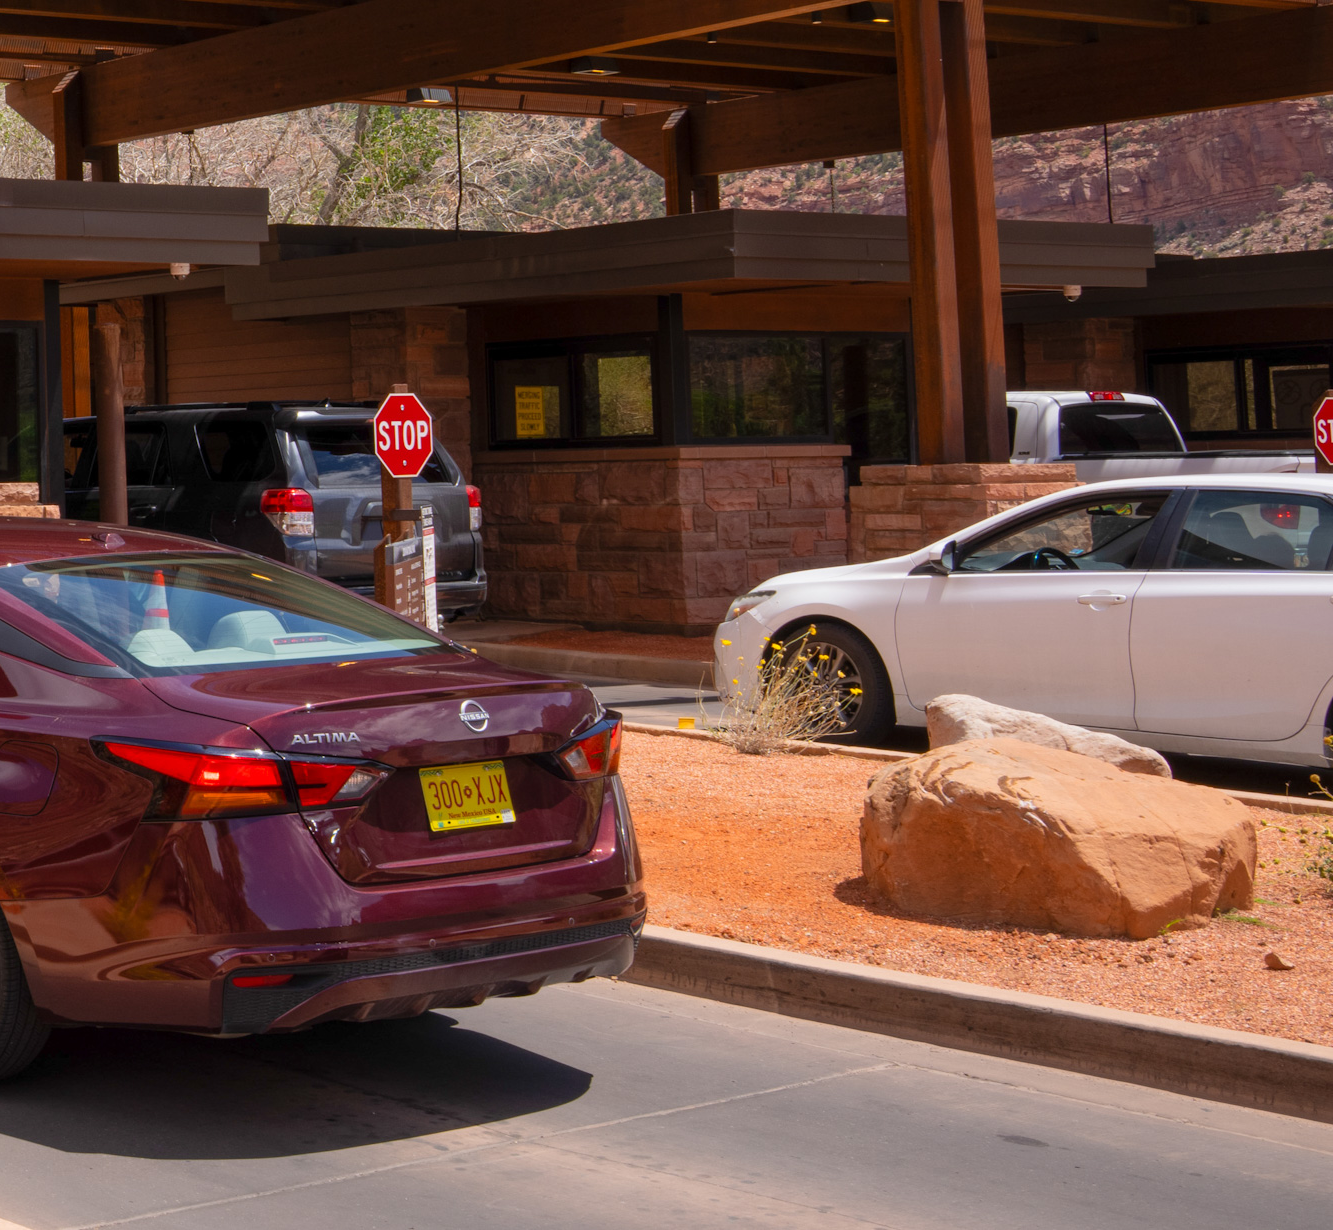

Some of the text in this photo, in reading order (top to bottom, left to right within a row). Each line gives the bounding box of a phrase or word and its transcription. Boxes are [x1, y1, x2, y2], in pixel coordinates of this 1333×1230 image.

[519, 402, 540, 410] TRAFFIC
[518, 412, 541, 420] PROCEED
[521, 423, 540, 431] SLOWLY
[378, 420, 429, 451] STOP
[1317, 419, 1333, 444] ST
[460, 712, 490, 721] NISSAN
[291, 732, 361, 745] ALTIMA
[461, 810, 483, 818] Mexico
